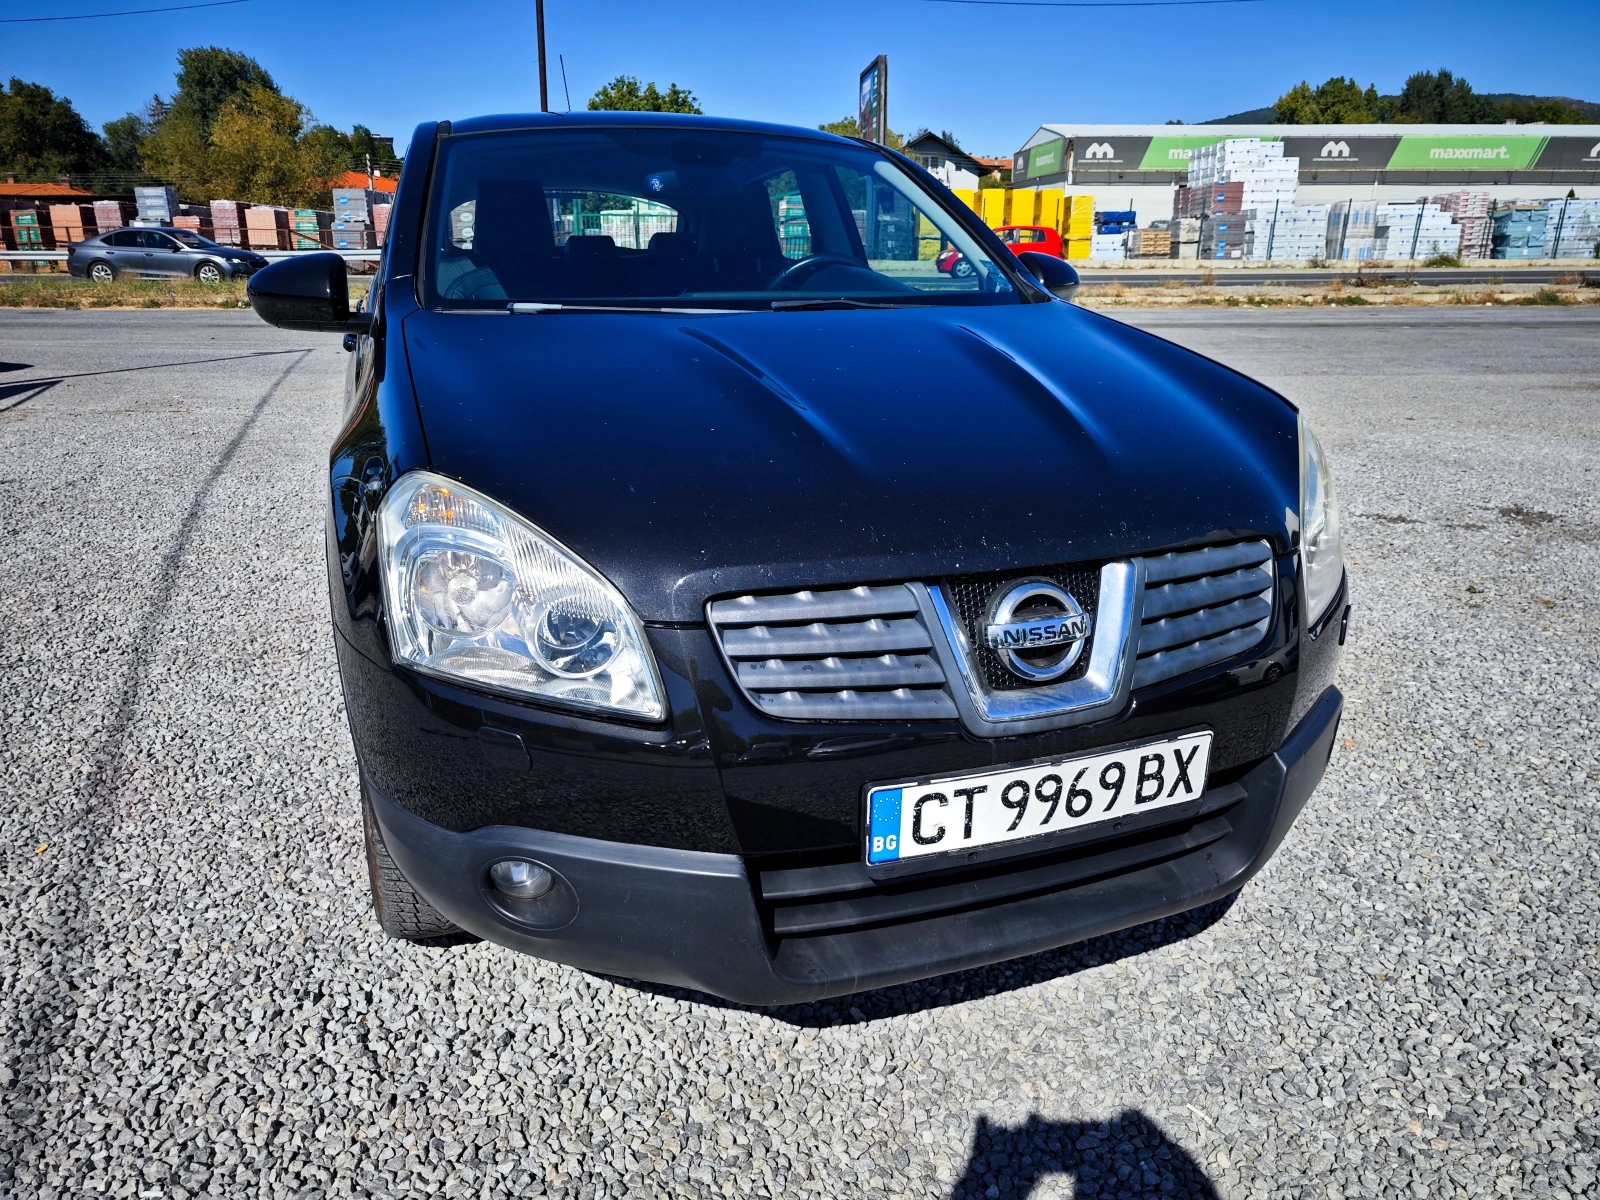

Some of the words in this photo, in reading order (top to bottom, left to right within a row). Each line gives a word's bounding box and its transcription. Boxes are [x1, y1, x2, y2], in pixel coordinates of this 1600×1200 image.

[1003, 619, 1086, 645] NISSAN
[911, 784, 988, 845] CT
[1000, 761, 1127, 833] 9969
[1134, 744, 1200, 806] BX
[872, 835, 898, 854] BG
